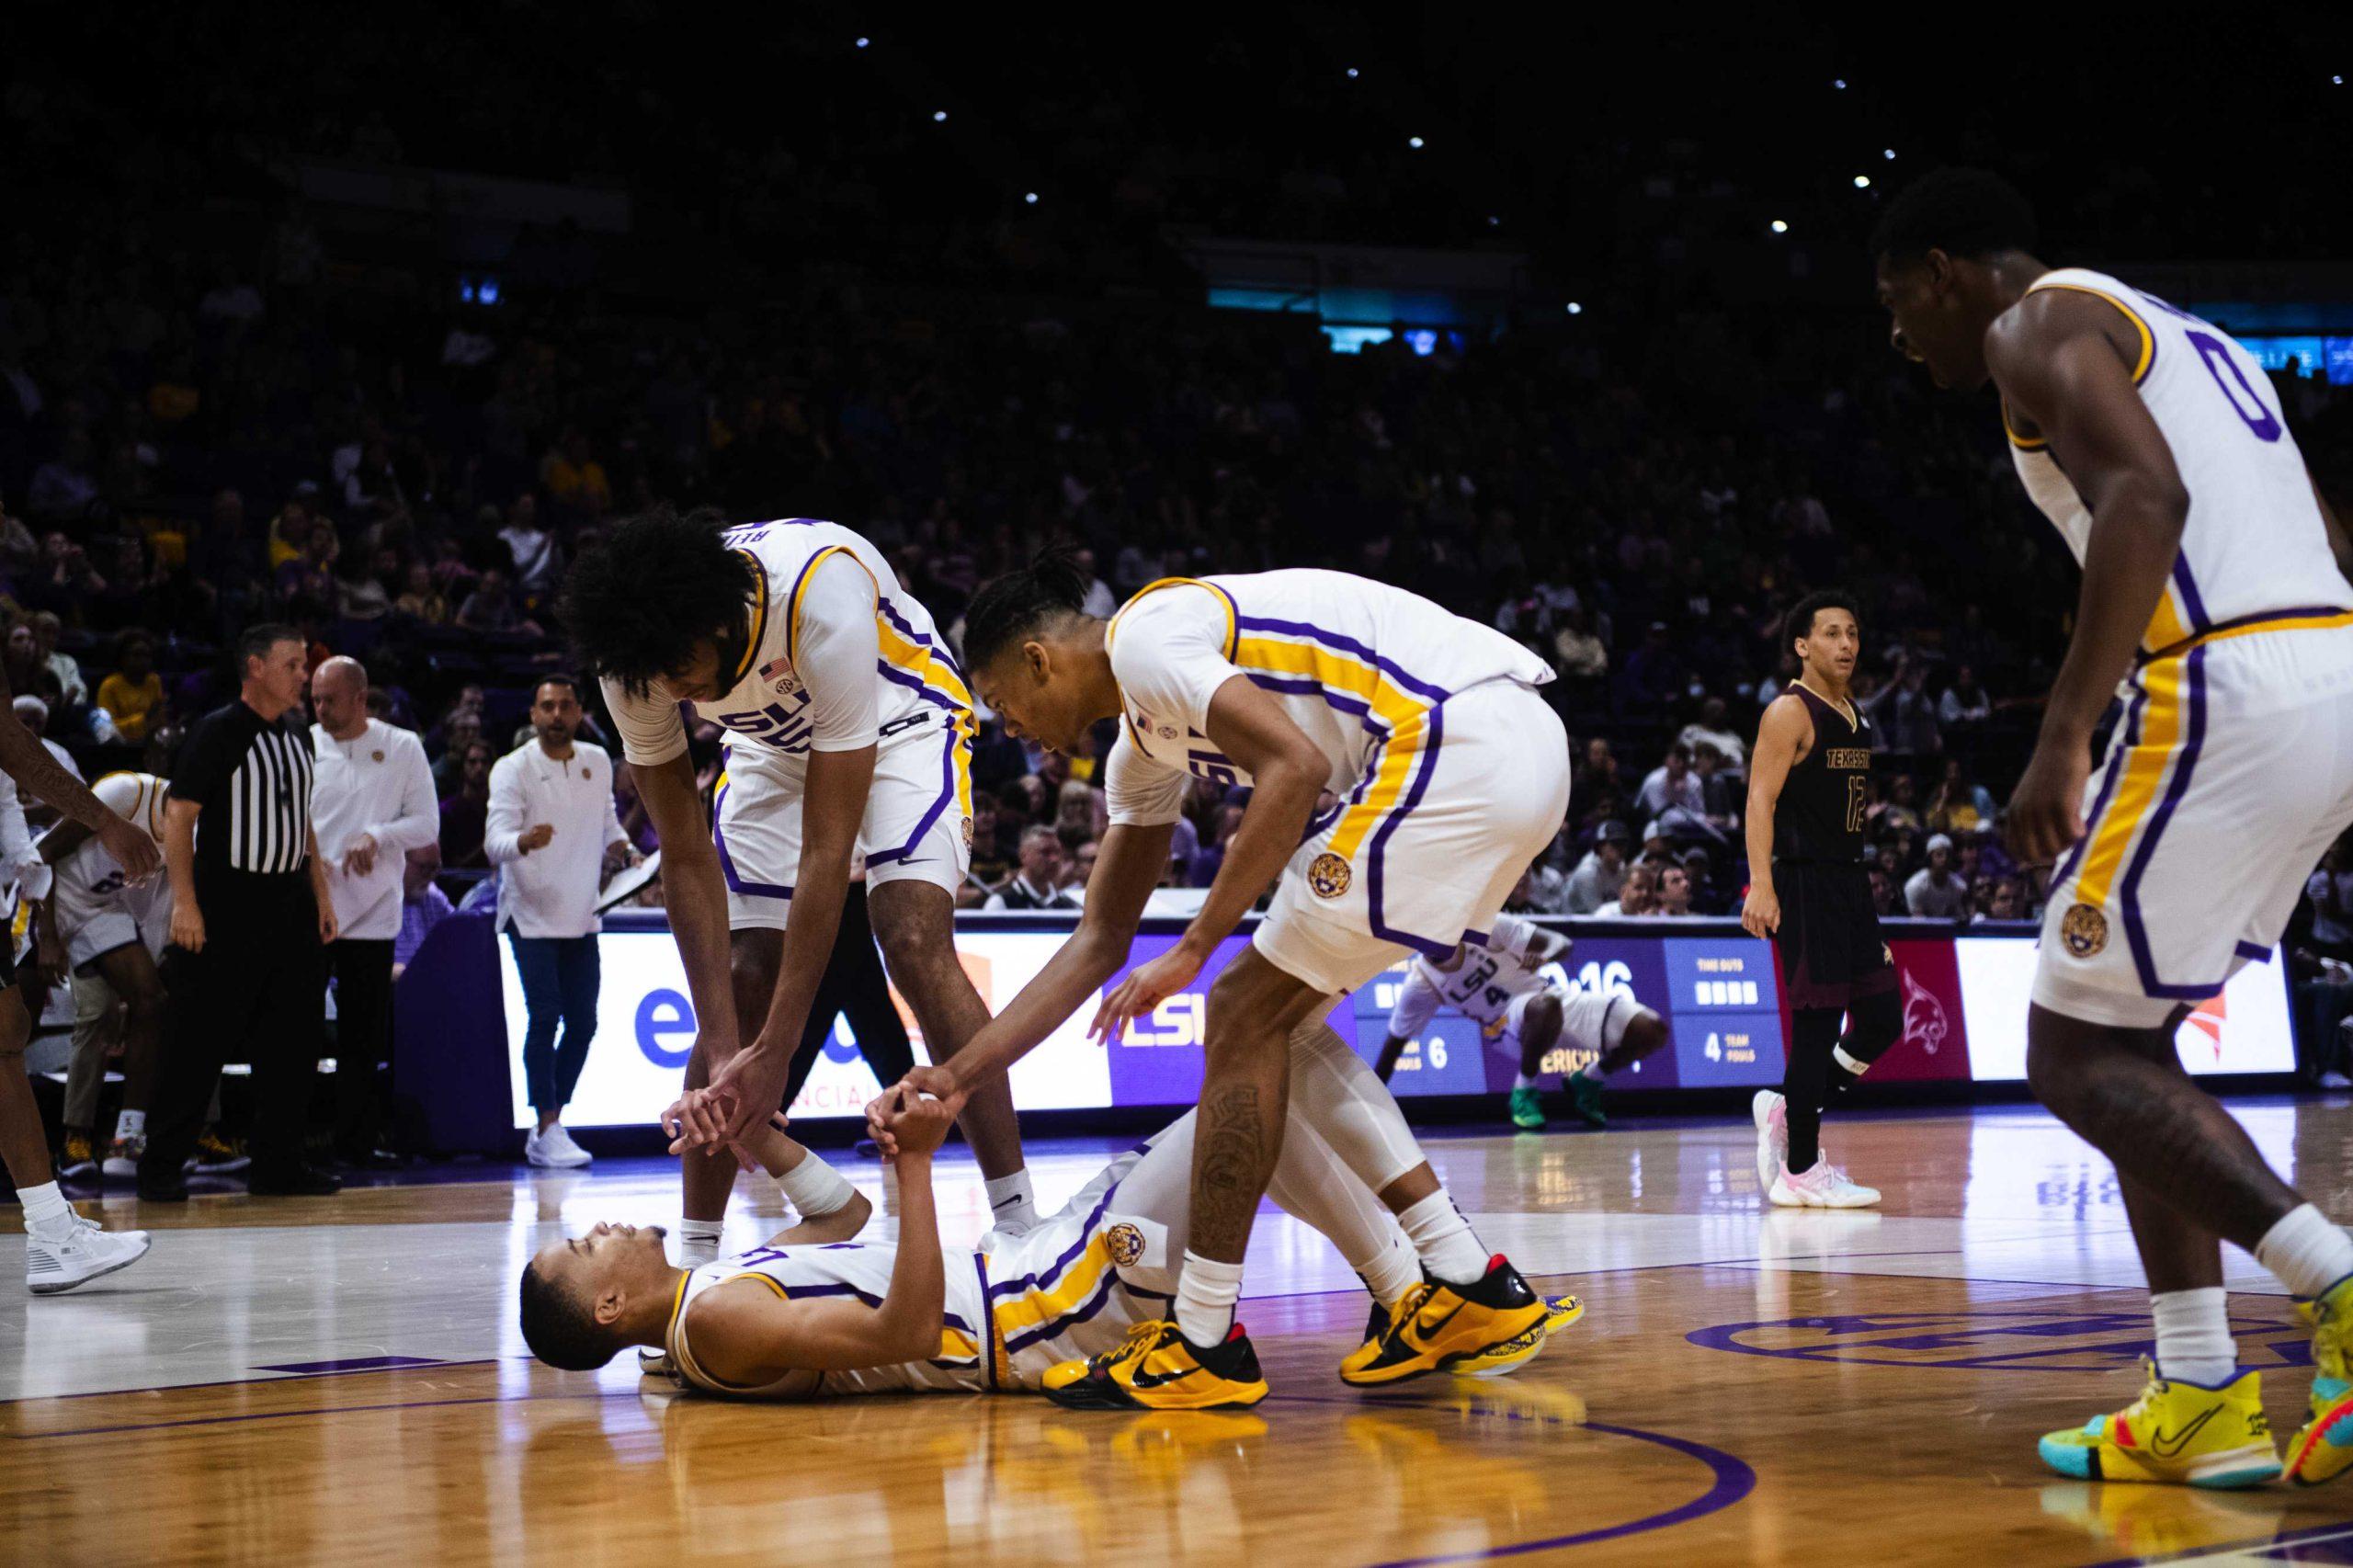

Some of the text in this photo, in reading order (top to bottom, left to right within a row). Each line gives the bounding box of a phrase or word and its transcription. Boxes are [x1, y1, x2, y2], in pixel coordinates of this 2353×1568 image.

[2184, 329, 2282, 443] 0
[1449, 958, 1499, 1004] LSU
[1484, 985, 1510, 1007] 4
[1428, 1036, 1449, 1069] 6
[1540, 1048, 1599, 1074] ERIOD
[1705, 1032, 1722, 1062] 4
